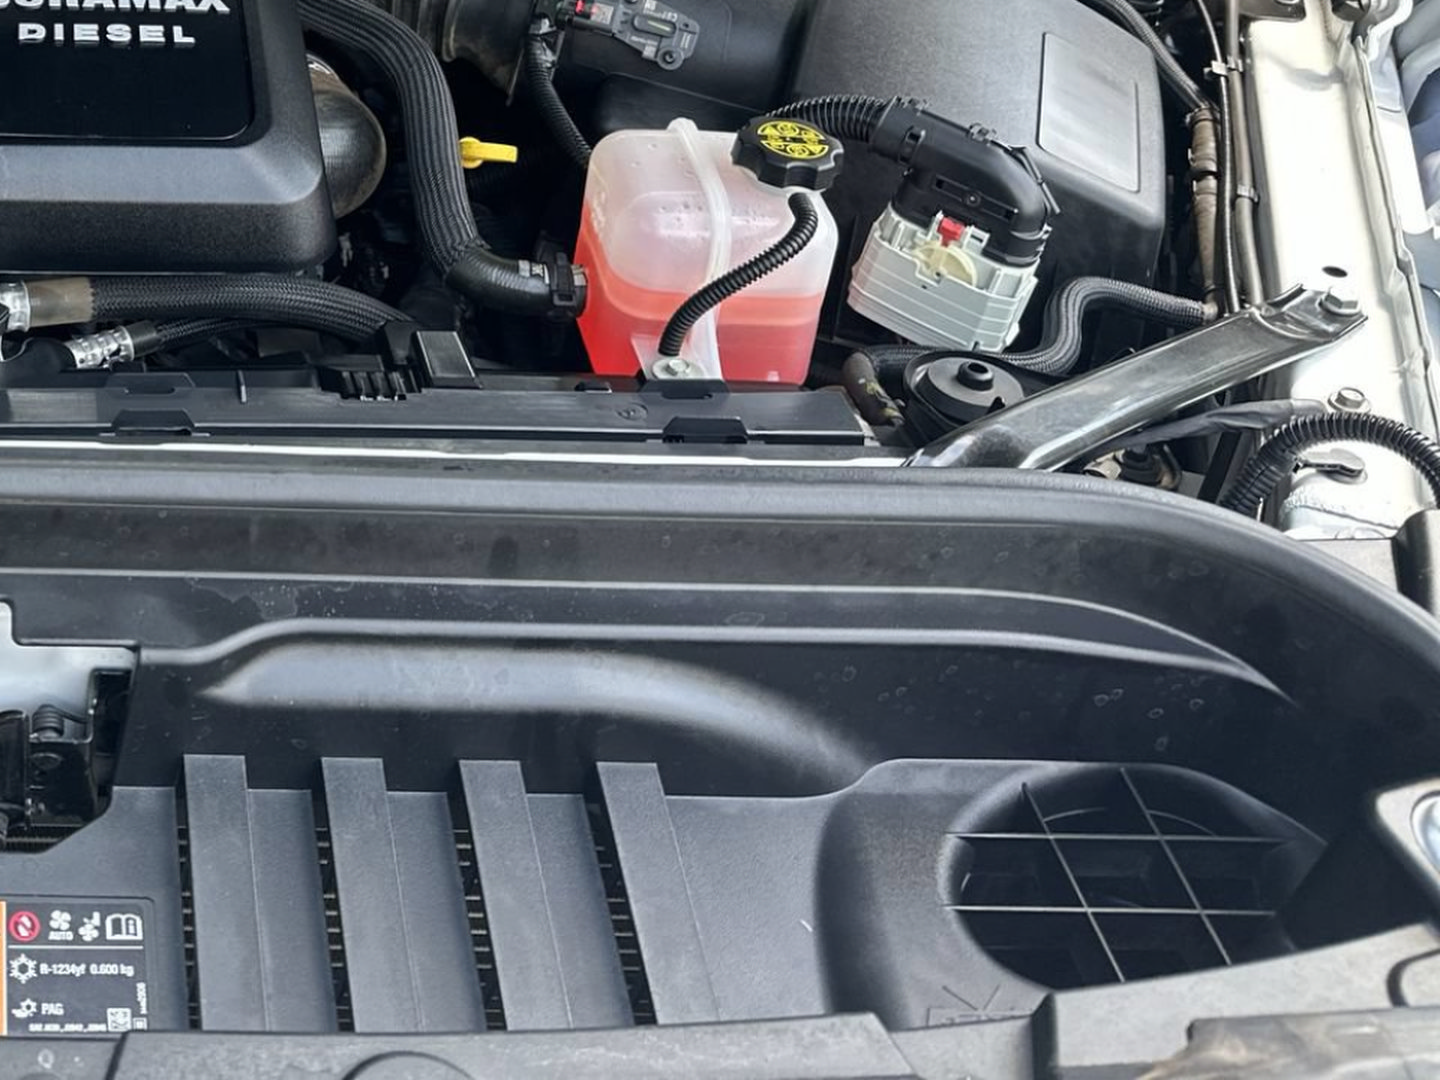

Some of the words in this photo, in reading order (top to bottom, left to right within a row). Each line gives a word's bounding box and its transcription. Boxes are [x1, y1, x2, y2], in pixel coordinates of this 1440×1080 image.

[18, 23, 195, 45] DIESEL
[40, 963, 86, 977] R-1234yf
[120, 963, 134, 977] kg
[41, 1003, 64, 1015] PAG
